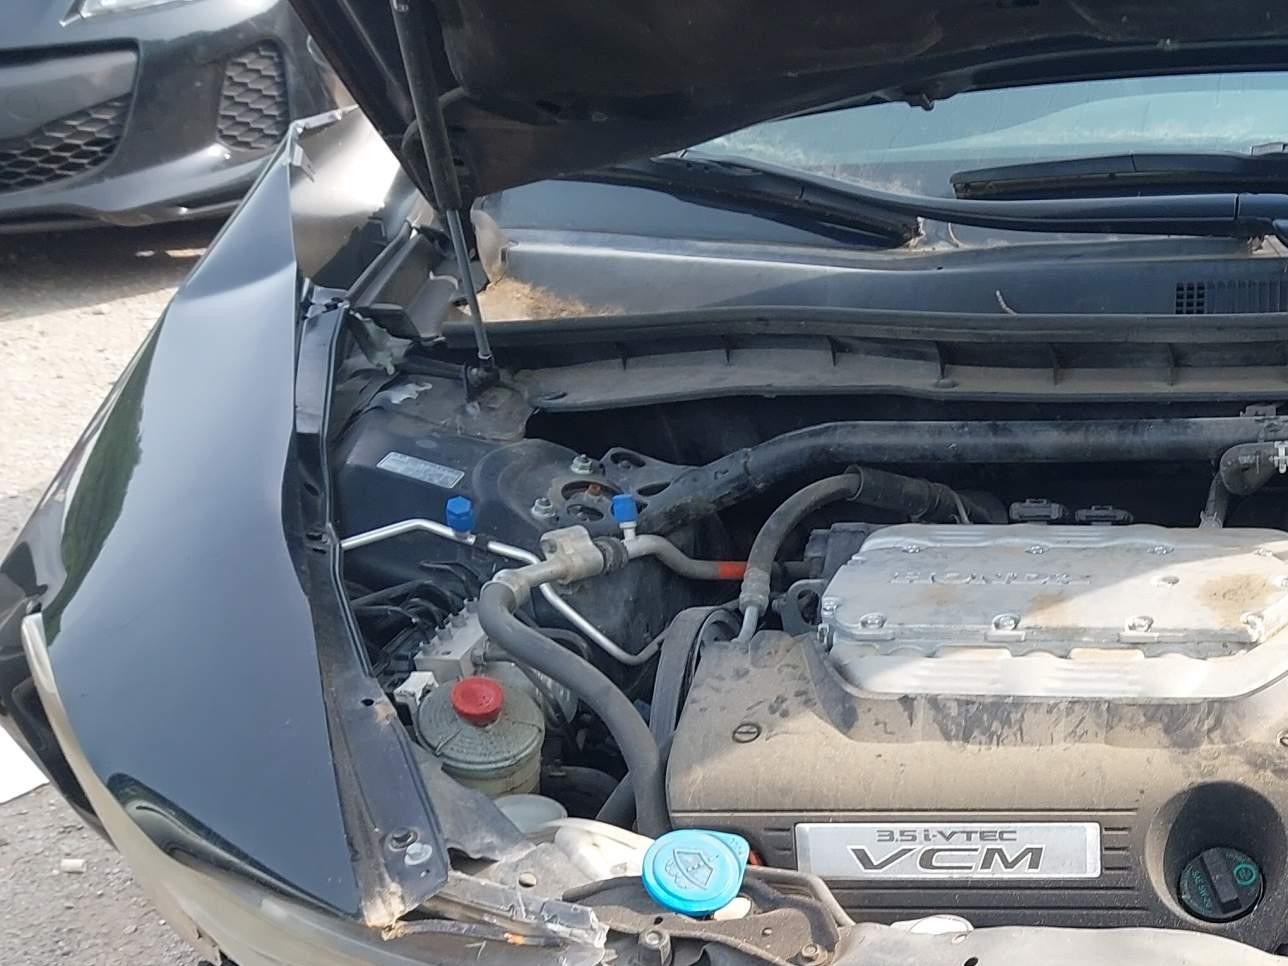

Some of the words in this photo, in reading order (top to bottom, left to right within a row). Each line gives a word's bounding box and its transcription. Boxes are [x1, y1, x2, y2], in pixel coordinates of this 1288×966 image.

[876, 829, 917, 842] 3.5
[923, 829, 1017, 842] i-VTEC
[848, 846, 1045, 871] VCM
